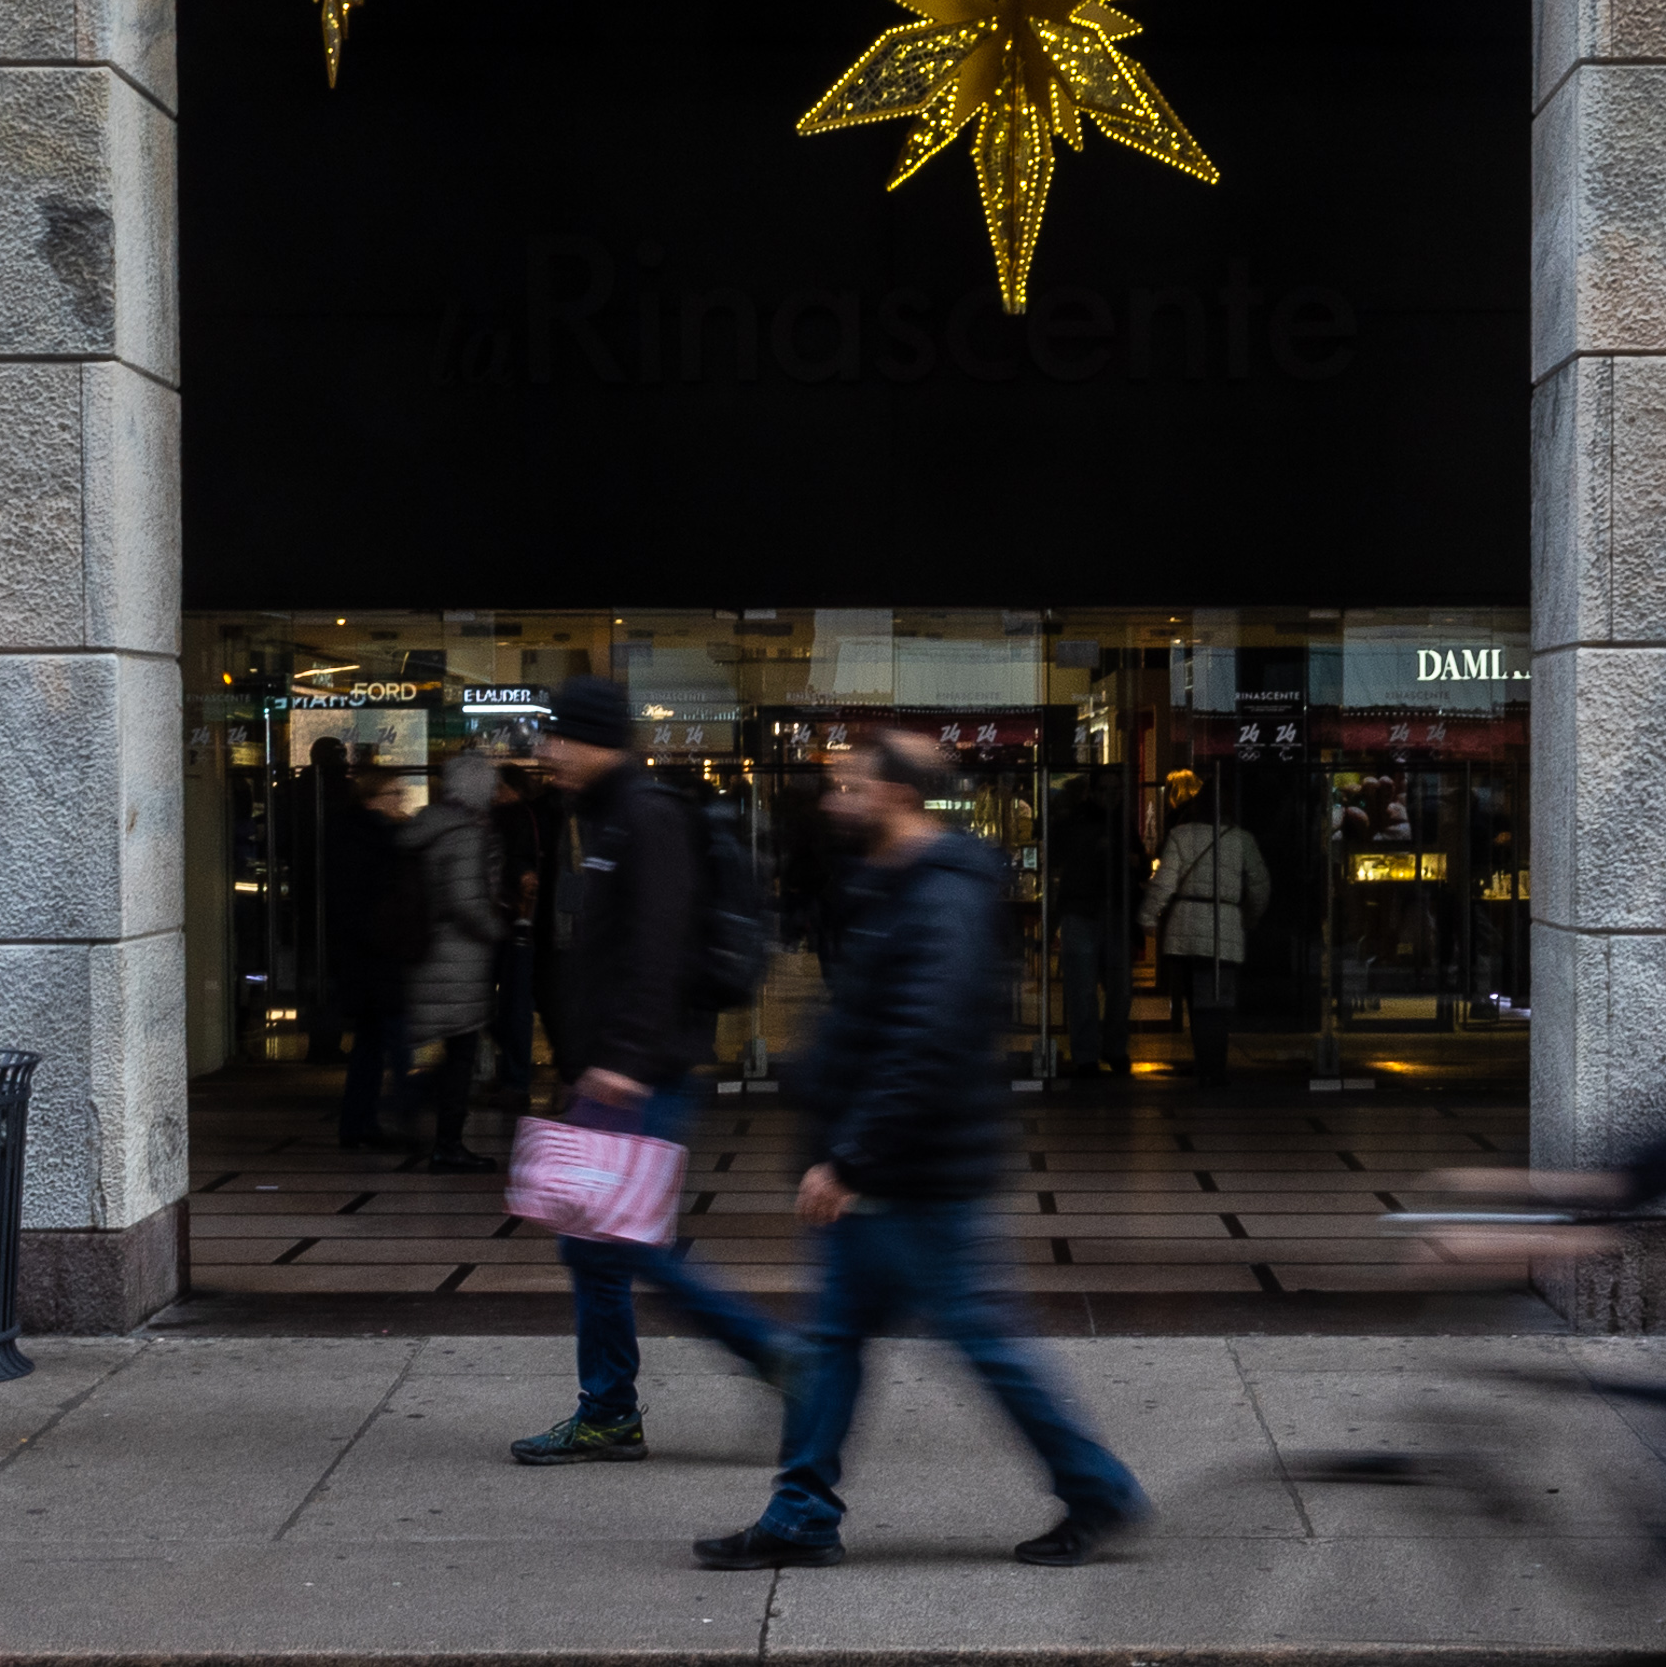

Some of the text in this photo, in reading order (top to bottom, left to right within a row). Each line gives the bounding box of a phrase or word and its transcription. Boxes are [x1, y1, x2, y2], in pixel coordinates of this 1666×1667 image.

[353, 682, 418, 702] FORD
[476, 688, 531, 703] LAUDER
[1235, 691, 1300, 701] RINASCENTE
